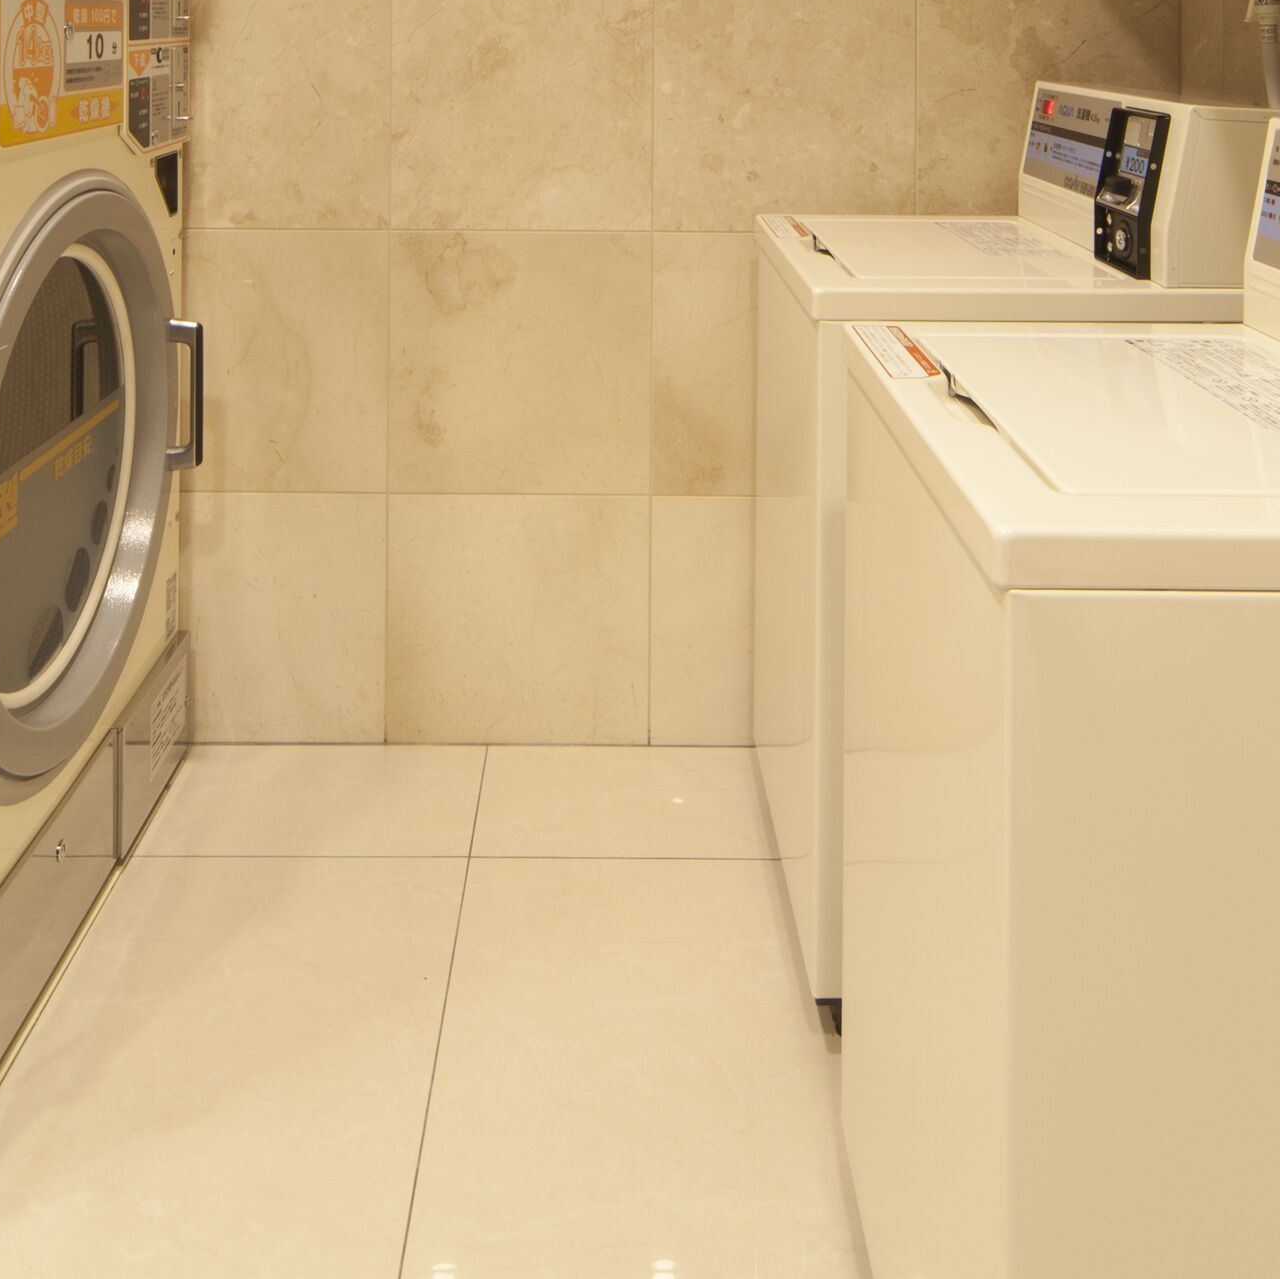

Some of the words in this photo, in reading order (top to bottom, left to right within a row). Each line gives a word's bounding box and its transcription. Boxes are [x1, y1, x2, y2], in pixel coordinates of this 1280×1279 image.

[16, 25, 52, 66] 14kg
[87, 33, 104, 60] 10
[78, 95, 111, 123] 乾燥機
[1125, 156, 1145, 174] ¥200
